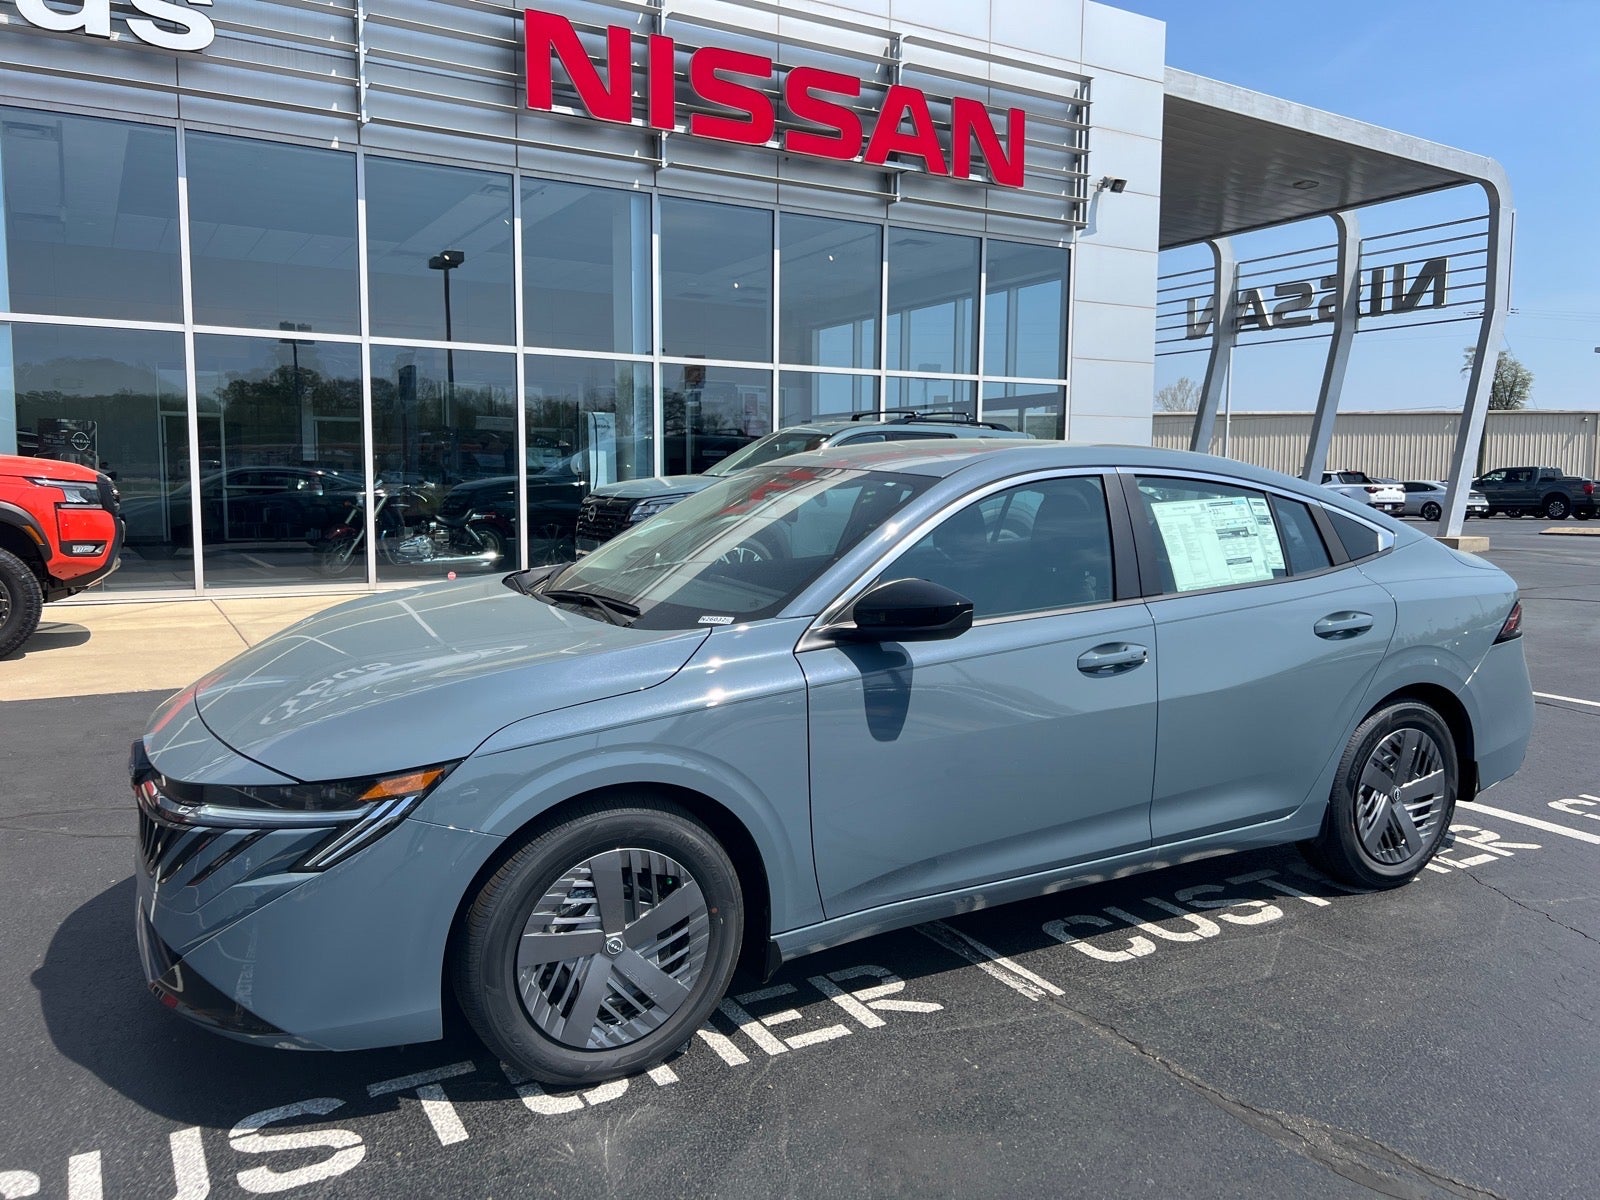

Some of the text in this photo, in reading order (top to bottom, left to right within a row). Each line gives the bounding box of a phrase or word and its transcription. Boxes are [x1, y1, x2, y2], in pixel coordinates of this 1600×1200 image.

[524, 8, 1025, 188] NISSAN
[1042, 824, 1542, 962] CUSTER
[0, 965, 944, 1200] USTER
